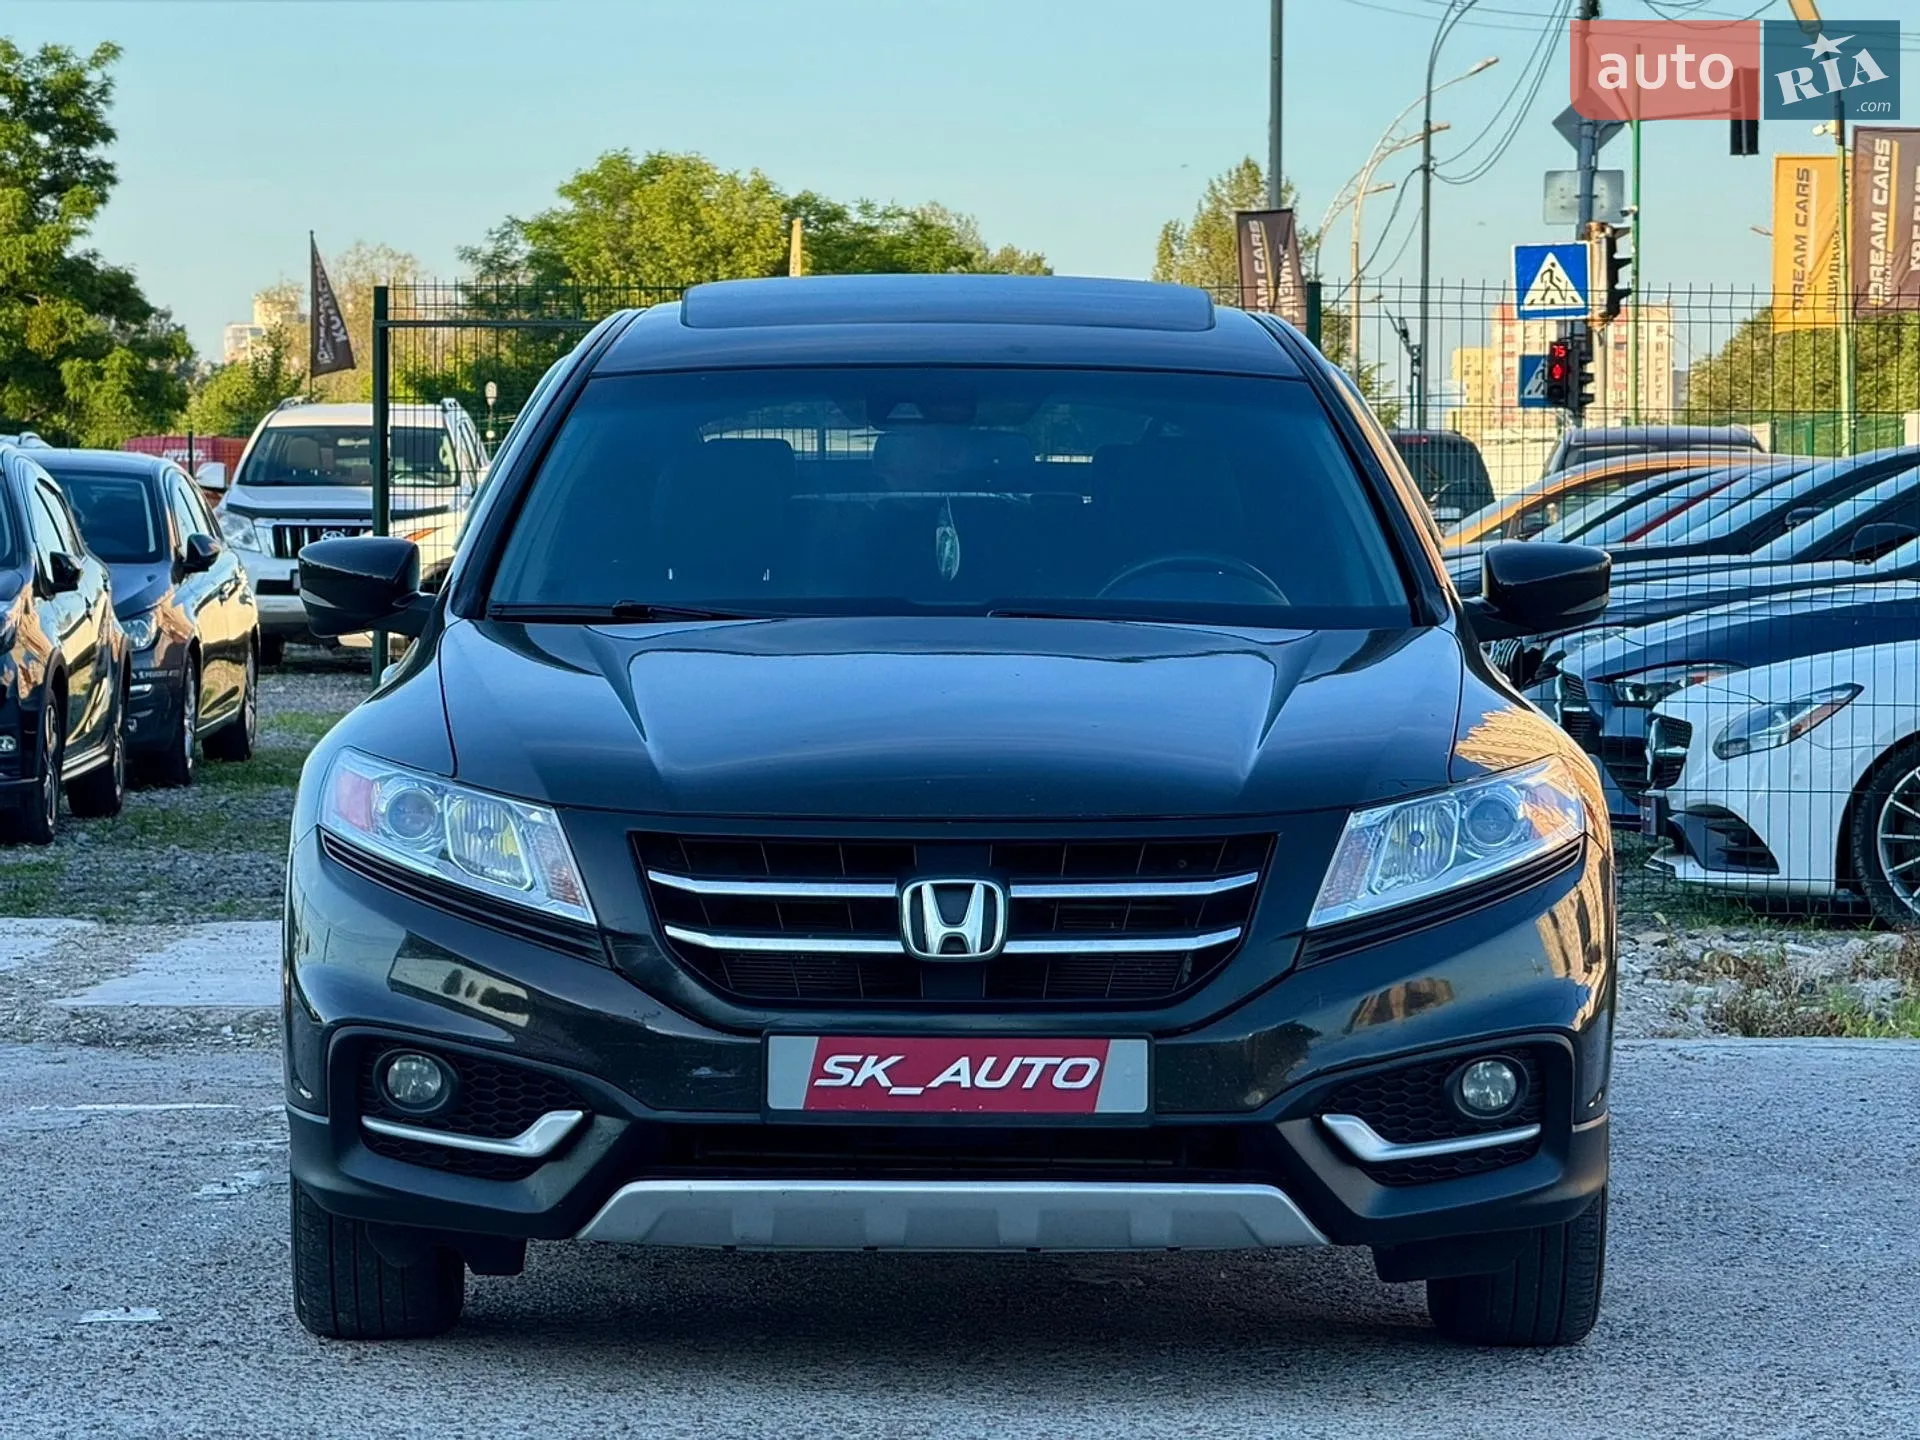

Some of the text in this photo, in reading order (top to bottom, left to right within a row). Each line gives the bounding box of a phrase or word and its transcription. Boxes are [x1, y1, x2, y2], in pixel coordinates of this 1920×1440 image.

[1794, 167, 1810, 228] CARS
[1869, 138, 1891, 303] DREAM CARS
[1248, 219, 1266, 274] CARS
[813, 1054, 1101, 1096] SK_AUTO
